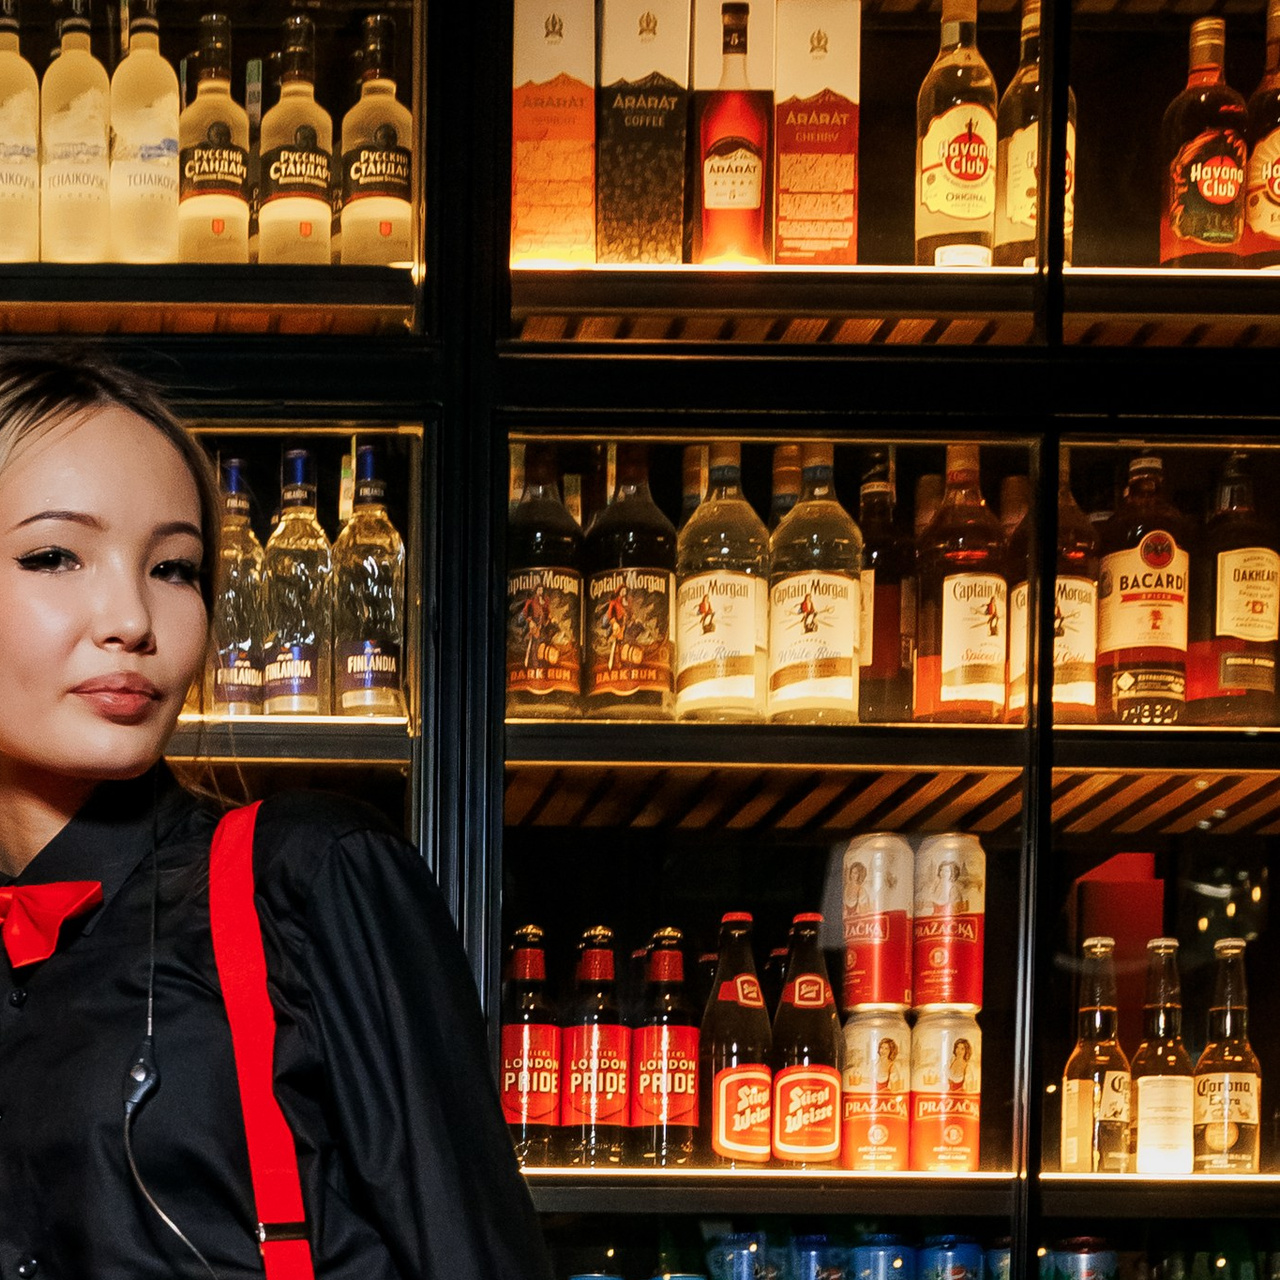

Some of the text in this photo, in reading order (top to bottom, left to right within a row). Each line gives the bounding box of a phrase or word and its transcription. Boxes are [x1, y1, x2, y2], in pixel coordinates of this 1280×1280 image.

[613, 93, 679, 111] ARARAT
[624, 114, 665, 128] COFFEE
[786, 109, 850, 127] ARARAT
[709, 163, 757, 175] ARARAT
[950, 156, 985, 175] Club
[1191, 162, 1244, 184] Havana
[1203, 179, 1236, 198] Club
[541, 570, 579, 595] Morgan
[590, 569, 666, 600] Captain Morgan
[708, 578, 749, 598] Morgan
[773, 578, 849, 606] Captain Morgan
[953, 580, 993, 602] Captain
[1056, 583, 1093, 606] Morgan
[712, 645, 741, 661] Rum
[777, 646, 842, 664] White Rum
[265, 659, 312, 681] FINLANDIA
[347, 654, 397, 674] FINLANDIA
[510, 668, 571, 681] DARK RUM
[596, 668, 657, 684] DARK RUM
[504, 1058, 559, 1070] LONDON
[570, 1057, 627, 1071] LONDON
[639, 1058, 696, 1072] LONDON
[504, 1071, 558, 1094] PRIDE
[570, 1072, 626, 1094] PRIDE
[639, 1072, 695, 1095] PRIDE
[1197, 1077, 1250, 1097] Corona
[788, 1085, 829, 1114] Stiegl
[1208, 1094, 1241, 1106] Extra
[784, 1104, 833, 1133] Weisse
